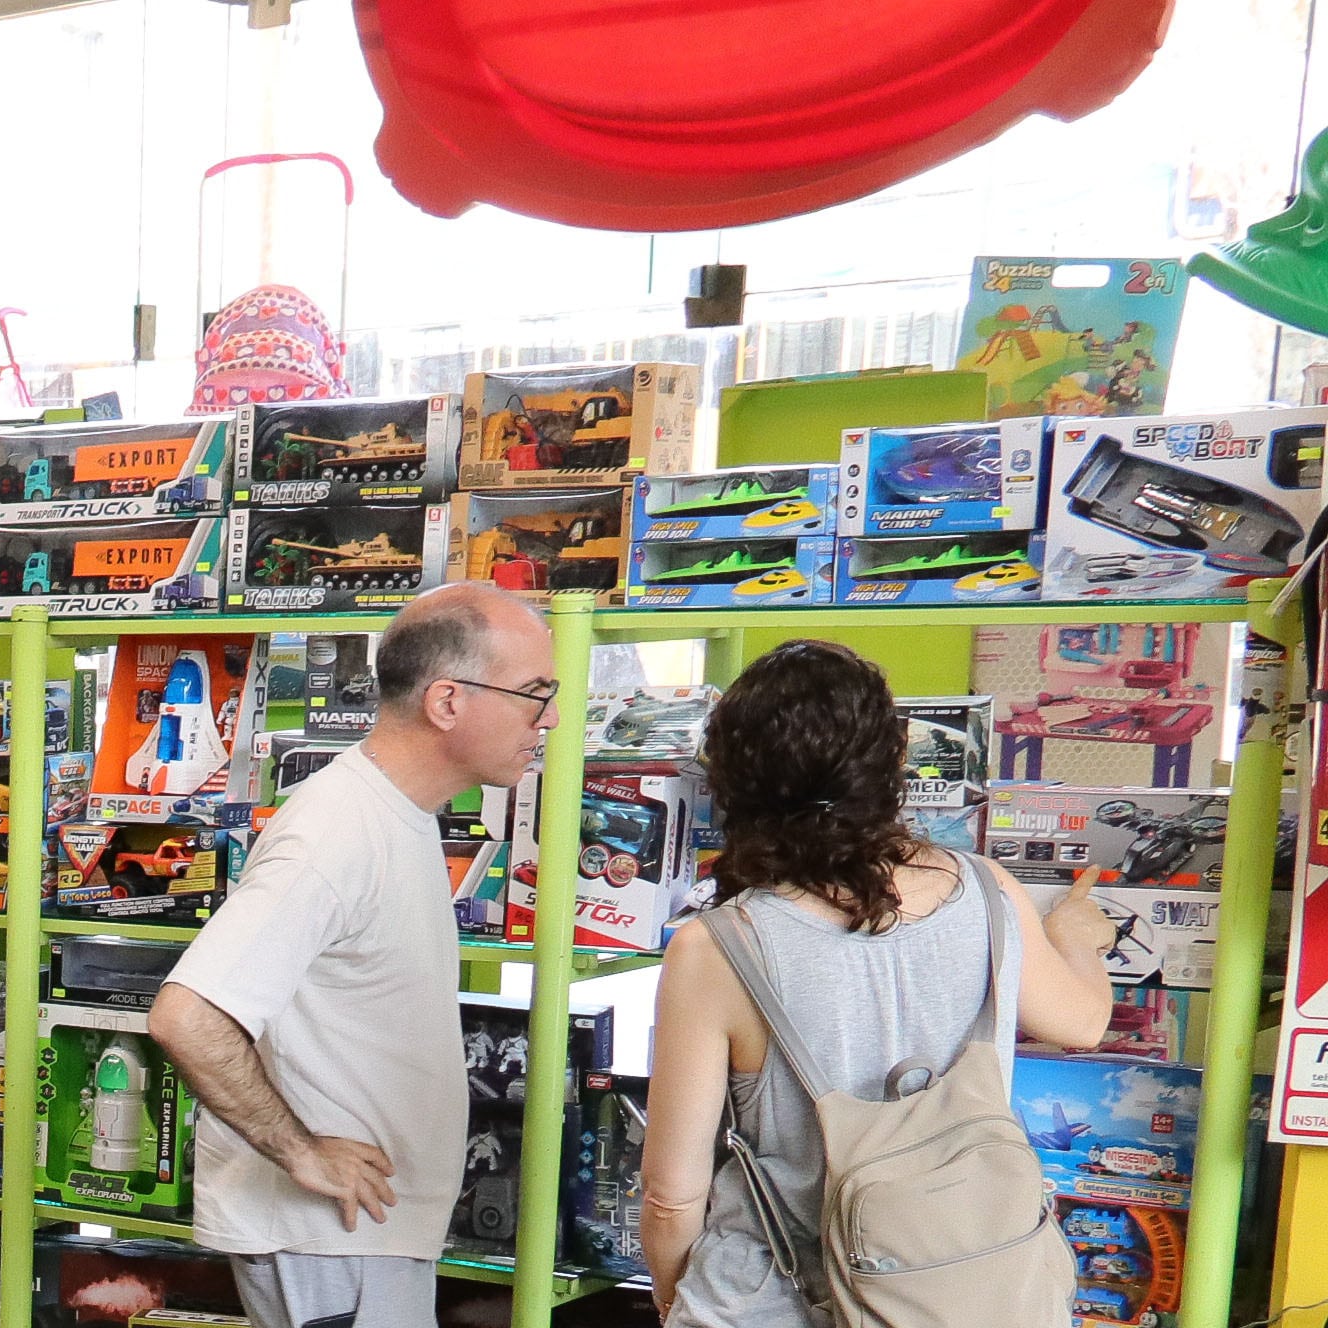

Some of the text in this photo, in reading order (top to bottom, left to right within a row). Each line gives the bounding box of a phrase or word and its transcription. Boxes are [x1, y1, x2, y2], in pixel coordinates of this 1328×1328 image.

[987, 261, 1053, 277] Puzzles
[983, 275, 1011, 294] 24
[108, 448, 177, 469] EXPORT
[250, 482, 331, 503] TANKS
[52, 502, 132, 518] TRUCK
[871, 508, 944, 521] MARINE
[879, 517, 931, 529] CORPS
[667, 530, 694, 539] BOAT
[106, 547, 174, 565] EXPORT
[244, 588, 326, 606] TANKS
[660, 596, 687, 604] BOAT
[845, 591, 901, 601] SPEED BOAT
[51, 597, 130, 611] TRUCK
[136, 667, 168, 677] SPAC
[309, 711, 377, 725] MARIN
[586, 781, 606, 792] THE
[106, 800, 162, 814] SPACE
[1017, 797, 1089, 809] MODEL
[64, 835, 107, 845] MONSTER
[75, 844, 94, 852] JAM
[70, 891, 89, 901] Toro
[90, 890, 112, 900] Loco
[592, 903, 636, 928] CAR
[1151, 901, 1219, 927] SWAT
[107, 993, 137, 1005] MODEL
[162, 1102, 170, 1157] EXPLORING
[1105, 1149, 1158, 1165] INTERESTING
[76, 1186, 134, 1202] EXPLORATION
[1082, 1182, 1131, 1195] Interesting
[1133, 1187, 1158, 1198] Train
